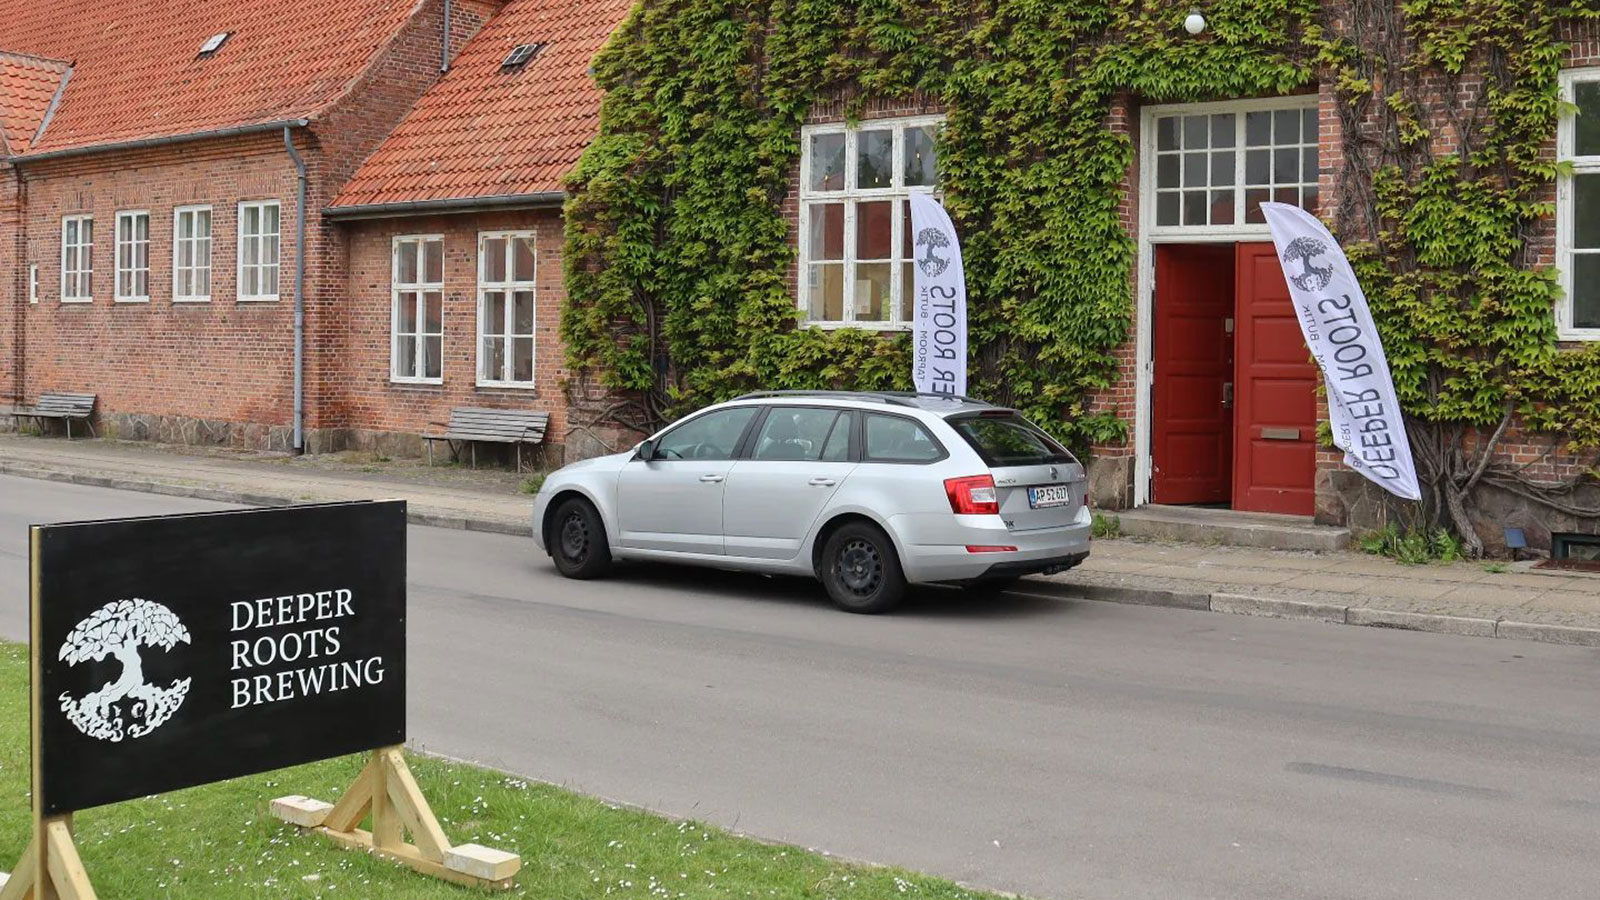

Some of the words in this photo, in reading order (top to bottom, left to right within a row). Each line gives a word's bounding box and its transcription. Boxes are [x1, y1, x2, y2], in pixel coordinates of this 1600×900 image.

[1036, 489, 1046, 502] AP
[1046, 488, 1056, 501] 52
[230, 588, 355, 631] DEEPER
[230, 627, 341, 670] ROOTS
[230, 657, 385, 709] BREWING
